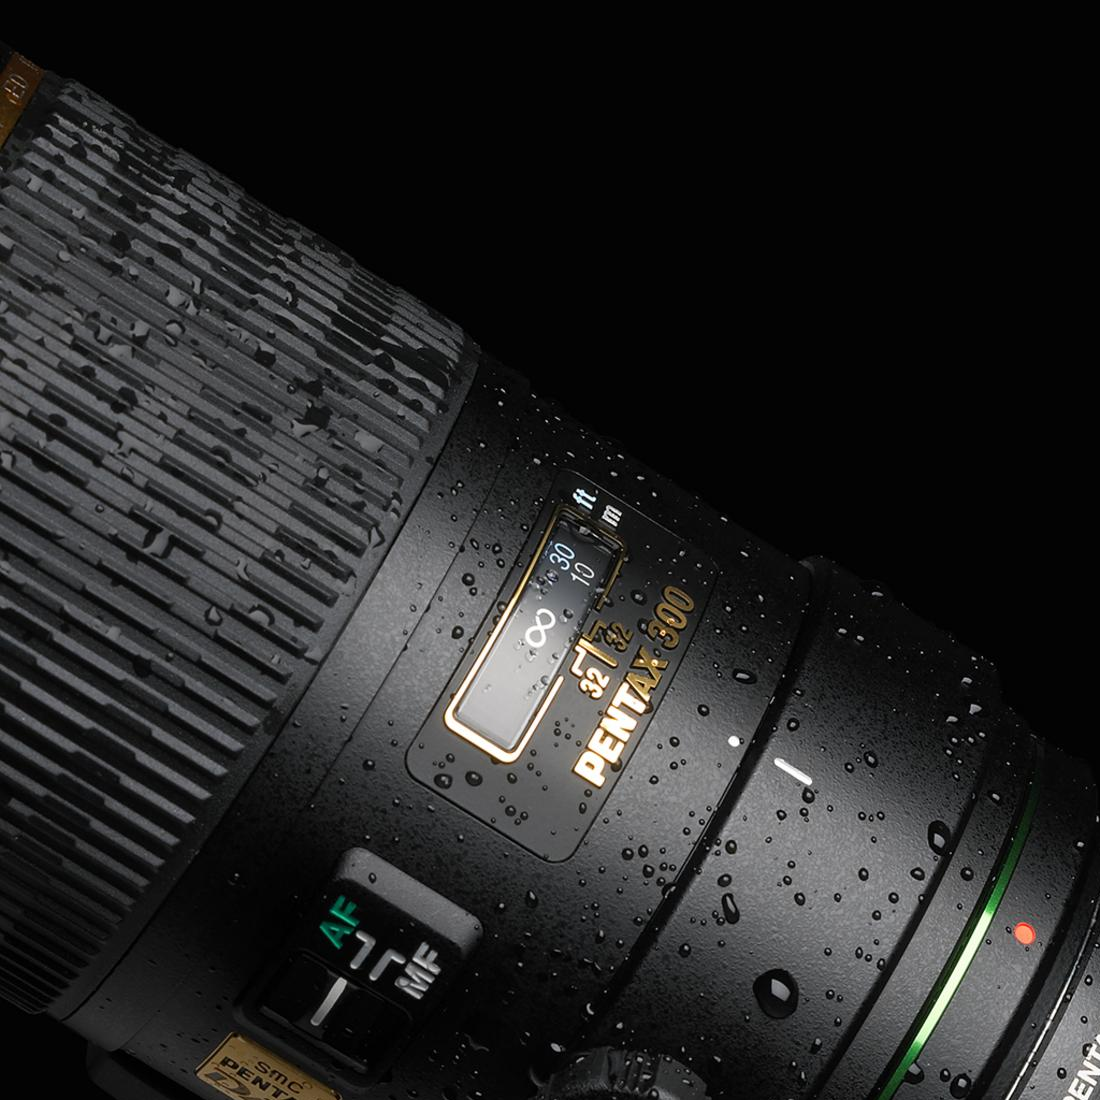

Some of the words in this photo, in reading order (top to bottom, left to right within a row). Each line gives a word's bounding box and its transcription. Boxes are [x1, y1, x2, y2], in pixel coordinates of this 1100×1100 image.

[573, 488, 597, 510] ft
[601, 505, 623, 527] m
[550, 543, 575, 570] 30
[570, 562, 595, 586] 10
[572, 646, 669, 788] PENTAX
[649, 585, 695, 649] 300
[578, 666, 610, 698] 32
[319, 895, 360, 949] AF
[395, 941, 442, 999] MF
[254, 1060, 305, 1094] smc
